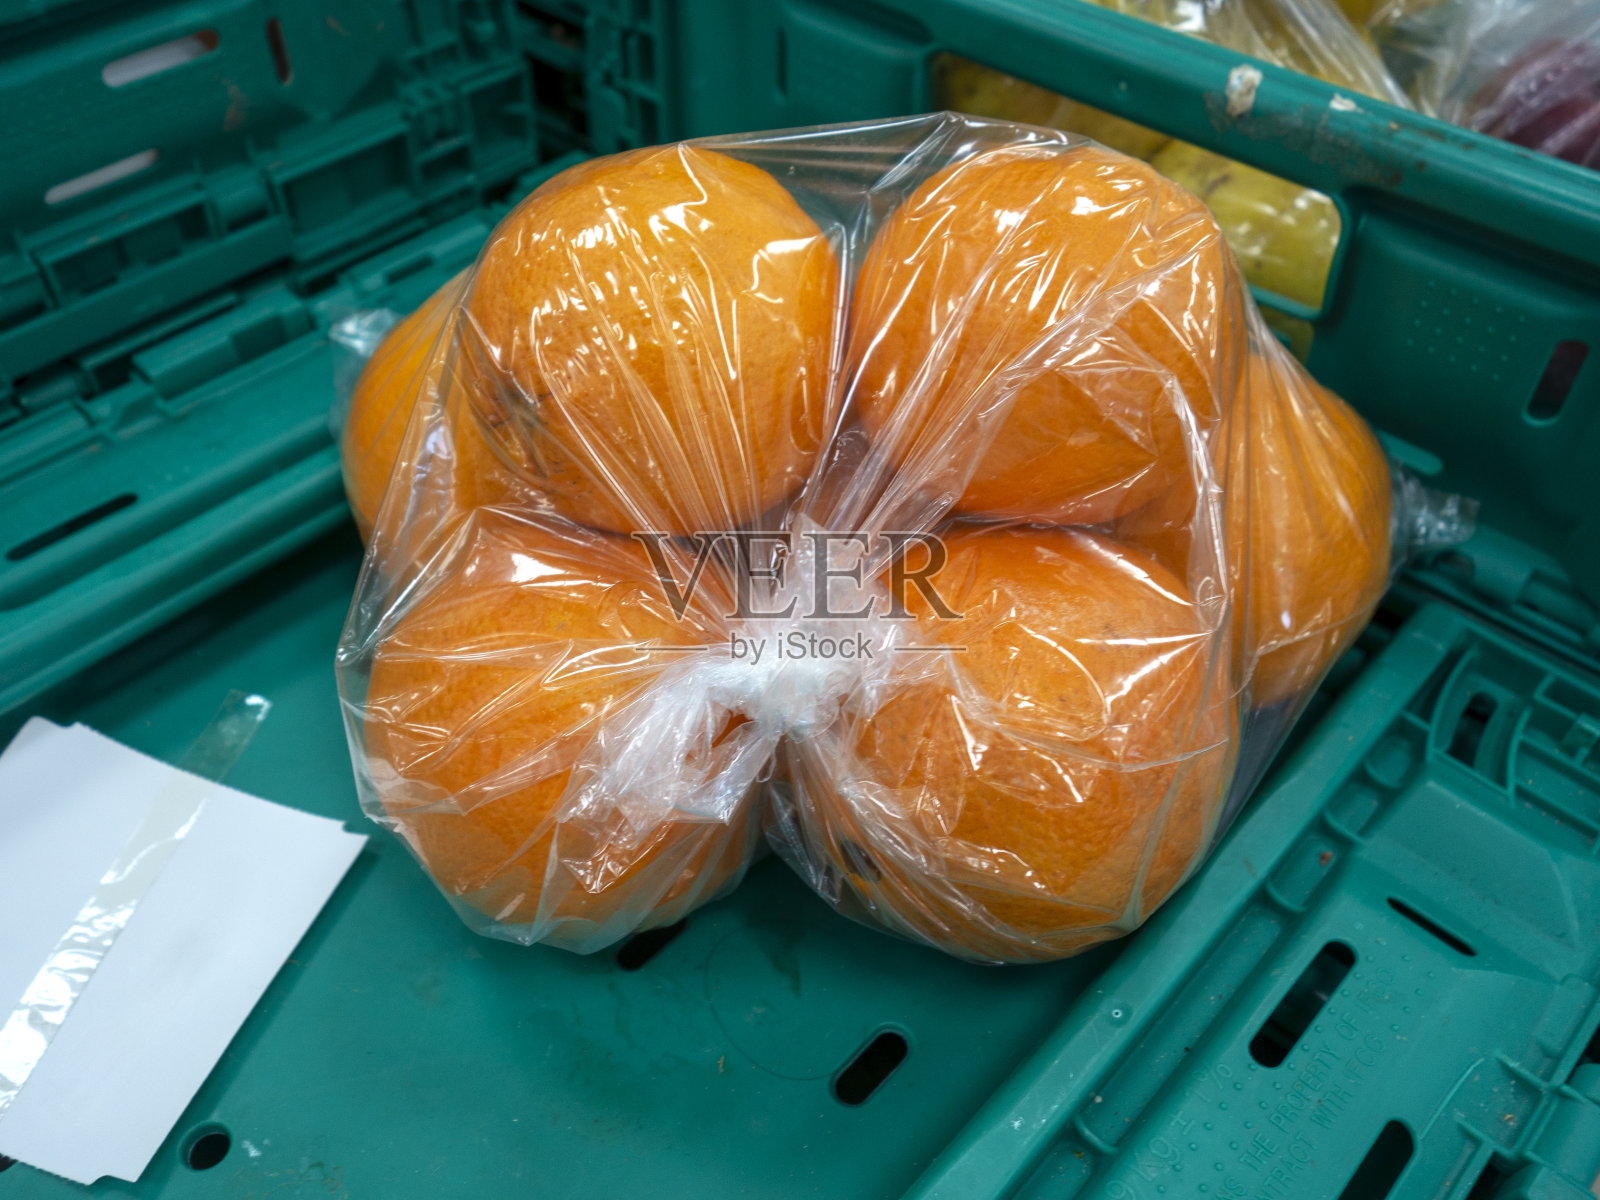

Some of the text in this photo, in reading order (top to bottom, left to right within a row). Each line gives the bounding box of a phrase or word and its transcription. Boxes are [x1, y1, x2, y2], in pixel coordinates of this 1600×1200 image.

[1238, 1131, 1279, 1170] THE
[1268, 1044, 1340, 1133] PROPERTY
[1335, 1011, 1359, 1038] OF
[1310, 1083, 1354, 1129] WITH
